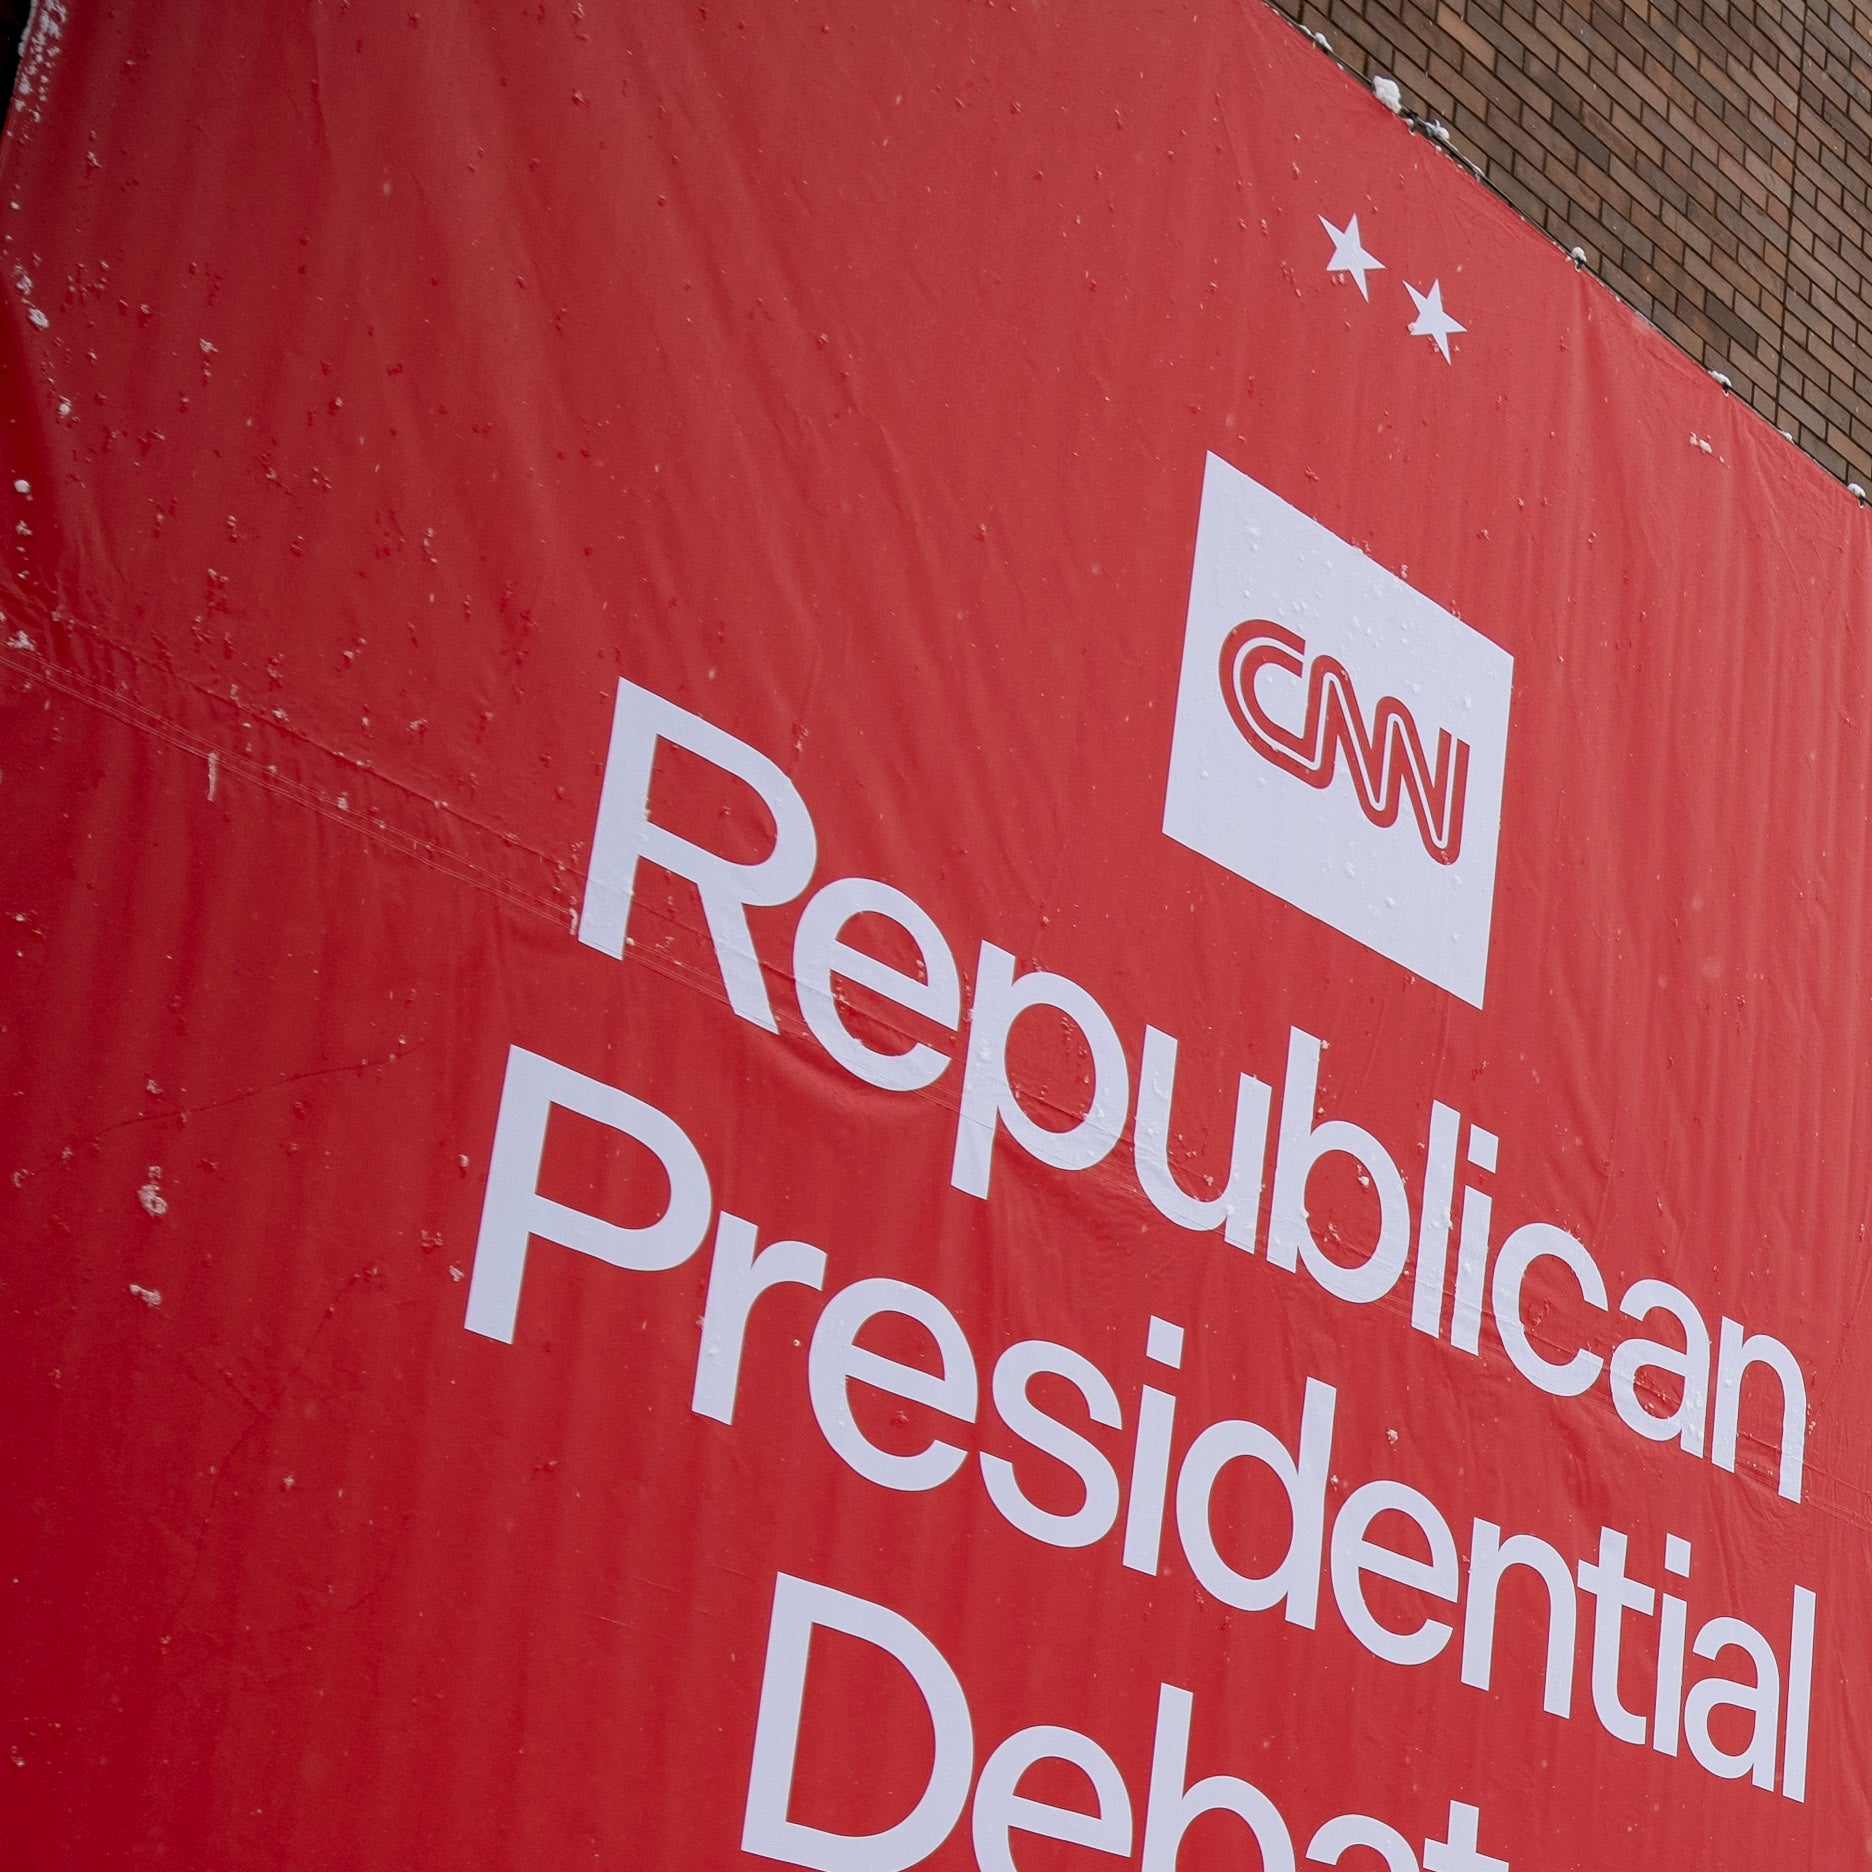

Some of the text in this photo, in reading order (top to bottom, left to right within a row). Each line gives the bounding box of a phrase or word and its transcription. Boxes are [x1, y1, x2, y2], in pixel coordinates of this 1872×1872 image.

[577, 677, 1807, 1504] Republican
[1219, 617, 1470, 864] CNN
[464, 1044, 1816, 1803] Presidential
